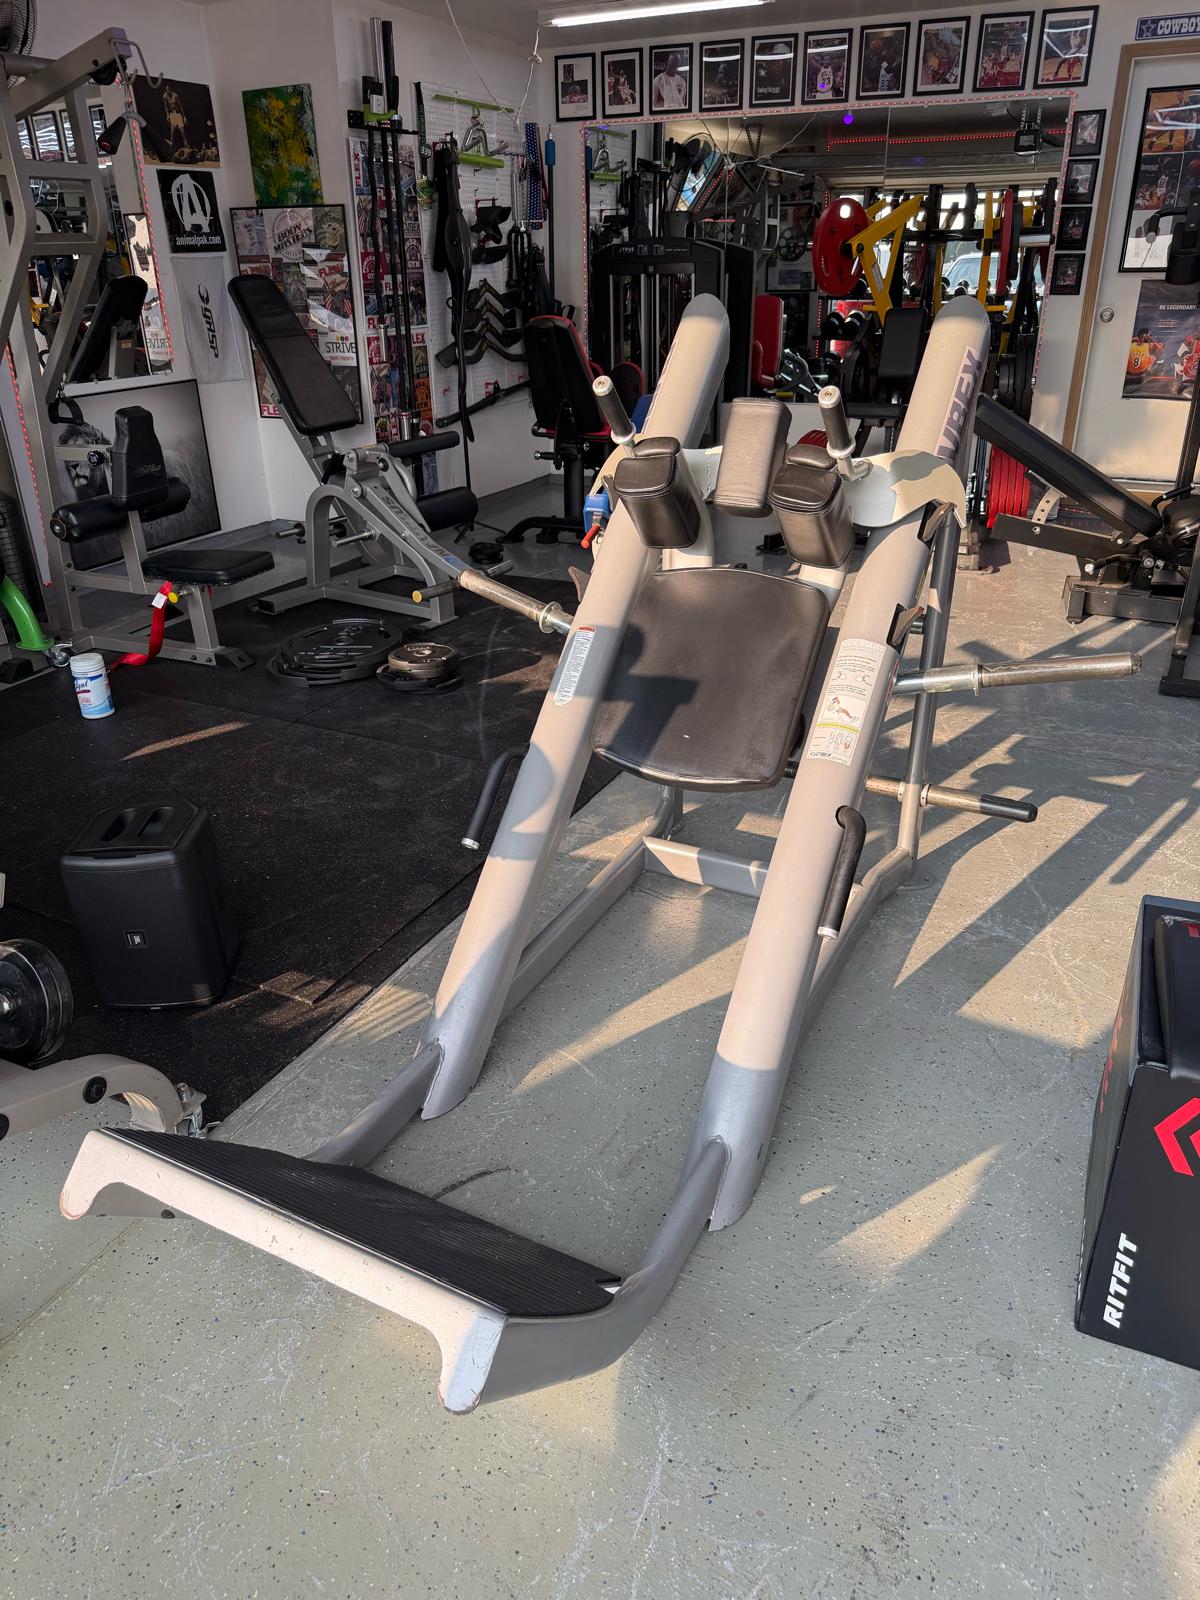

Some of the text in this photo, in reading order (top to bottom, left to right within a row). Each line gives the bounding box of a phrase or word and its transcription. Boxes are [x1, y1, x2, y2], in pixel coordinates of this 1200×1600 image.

[175, 235, 222, 247] animalpak.com
[325, 340, 357, 354] STRIVE
[1104, 1232, 1138, 1328] RITFIT
